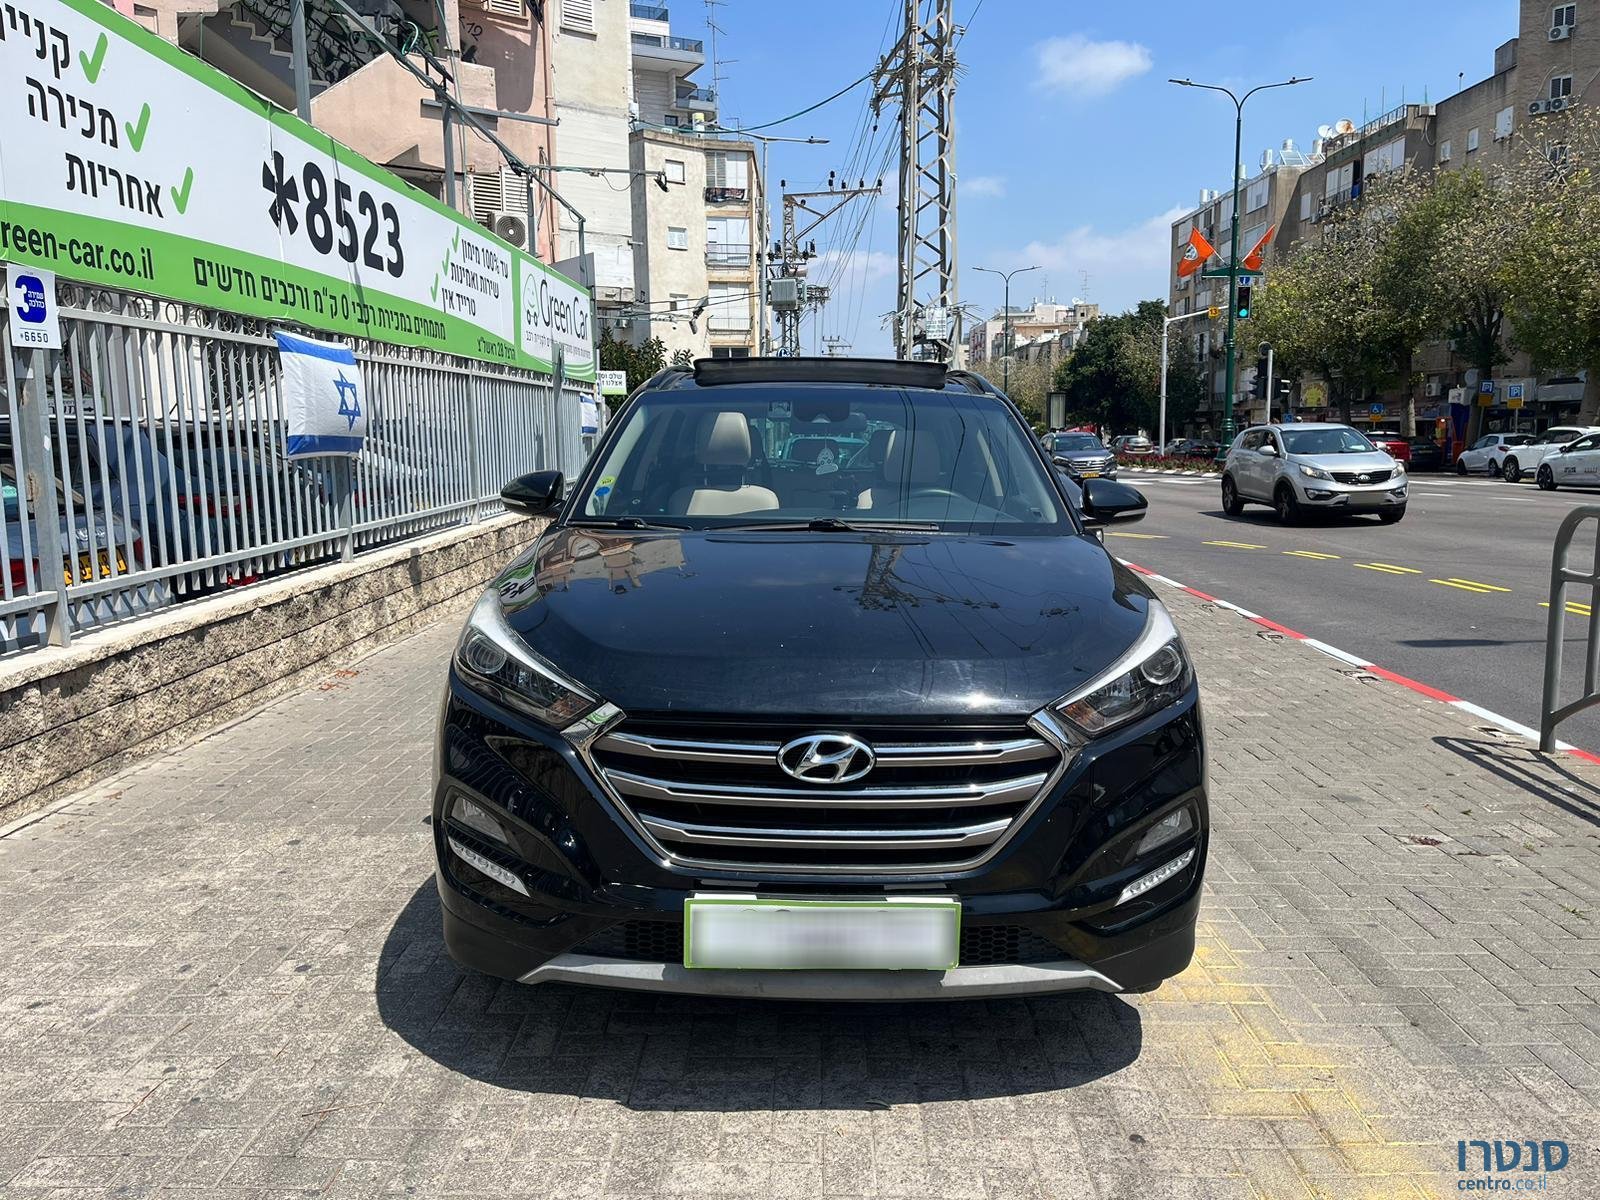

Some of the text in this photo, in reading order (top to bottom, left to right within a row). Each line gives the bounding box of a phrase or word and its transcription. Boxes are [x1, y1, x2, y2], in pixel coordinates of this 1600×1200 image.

[25, 76, 118, 149] מכירה
[65, 152, 164, 218] אחריות
[461, 239, 509, 279] עד 100% מימון
[193, 257, 257, 298] חדשים
[261, 275, 310, 311] ורכבים
[450, 262, 499, 299] שירות ואמינות
[342, 294, 349, 320] 0
[352, 302, 376, 326] רכבי
[441, 288, 476, 316] טרייד אין
[573, 296, 589, 340] Car
[378, 308, 412, 333] במכירת
[414, 316, 447, 340] מתמחים
[497, 342, 504, 357] 28
